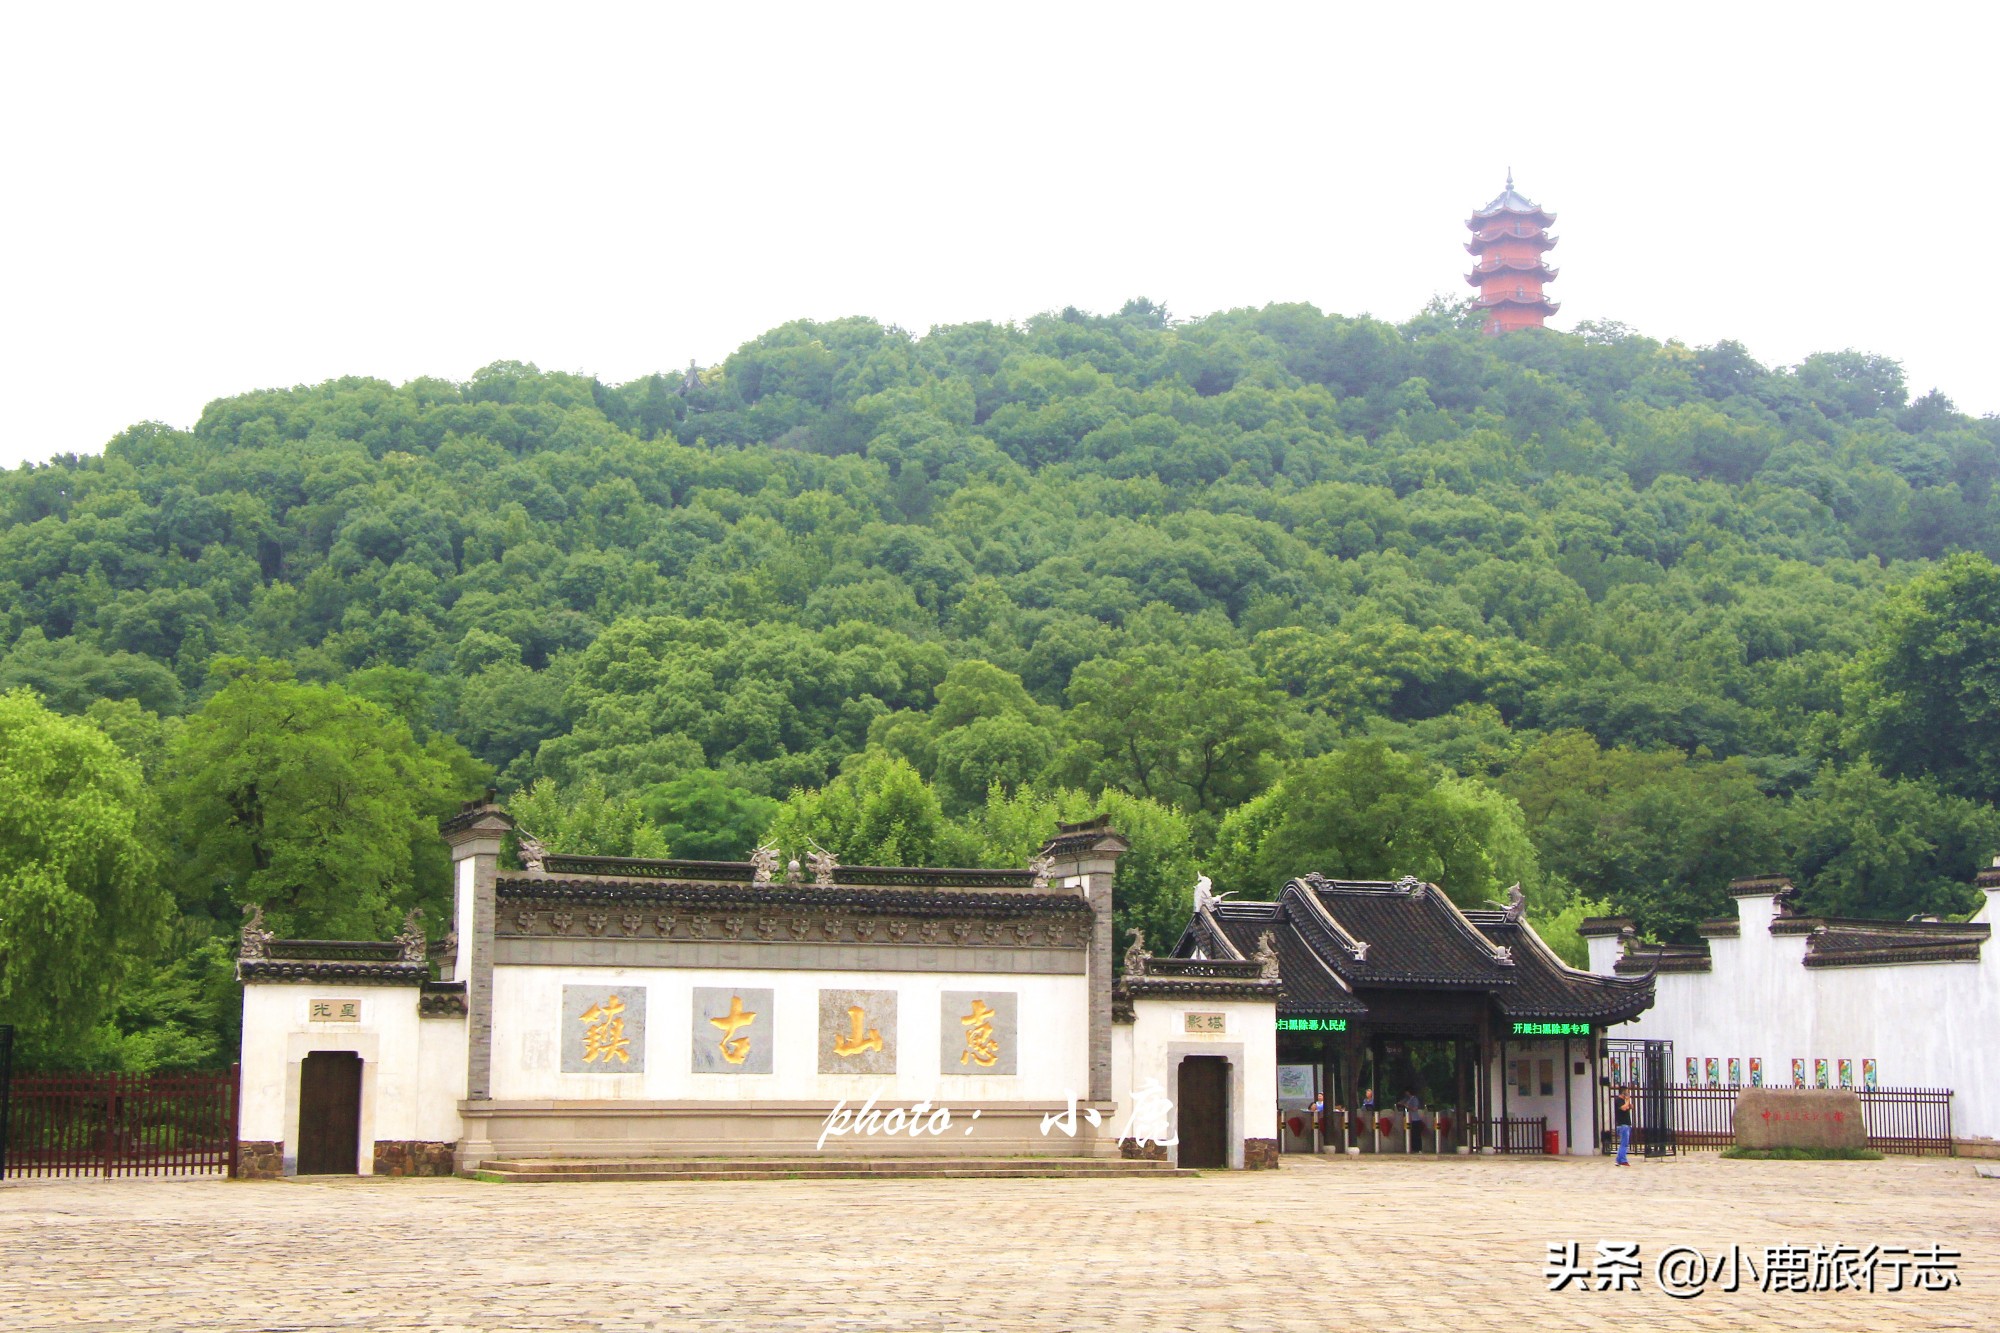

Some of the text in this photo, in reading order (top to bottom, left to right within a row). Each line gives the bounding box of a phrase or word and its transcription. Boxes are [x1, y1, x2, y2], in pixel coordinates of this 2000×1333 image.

[1512, 1023, 1590, 1035] 开展扫黑除恶专项
